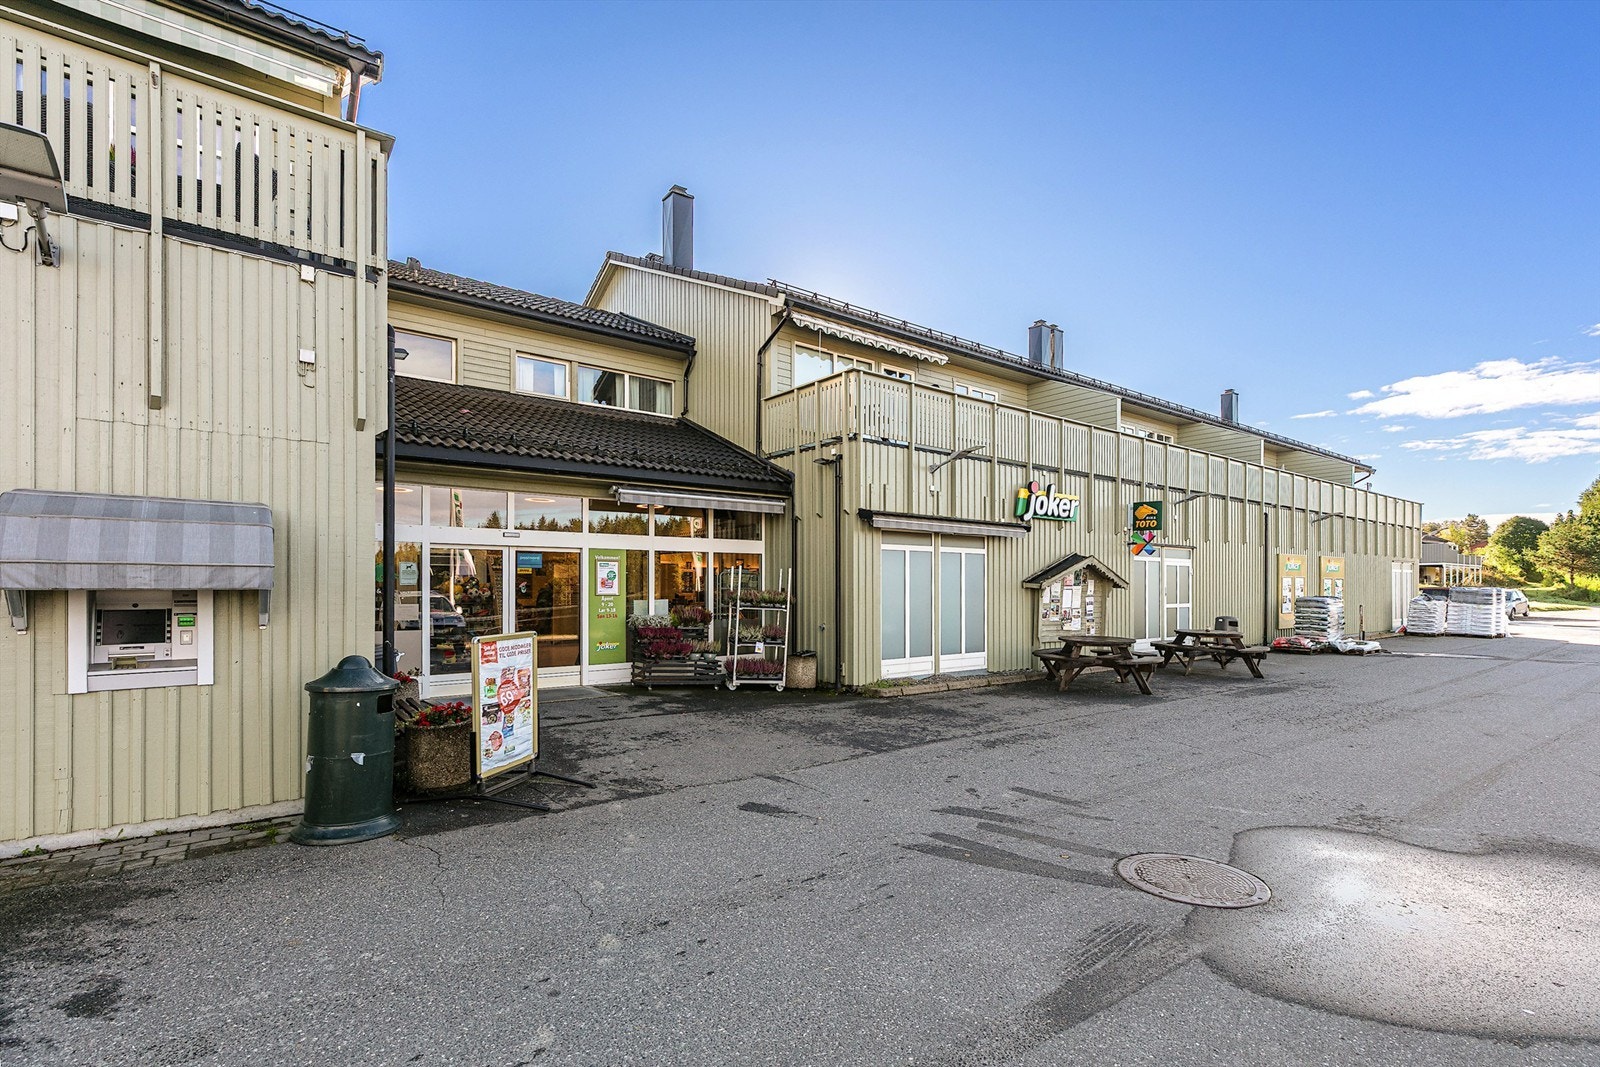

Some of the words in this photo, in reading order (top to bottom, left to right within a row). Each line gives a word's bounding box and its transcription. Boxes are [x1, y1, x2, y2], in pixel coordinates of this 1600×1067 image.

[1022, 481, 1080, 522] joker
[1135, 520, 1158, 528] TOTO
[597, 641, 619, 651] joker
[500, 690, 514, 706] 69
